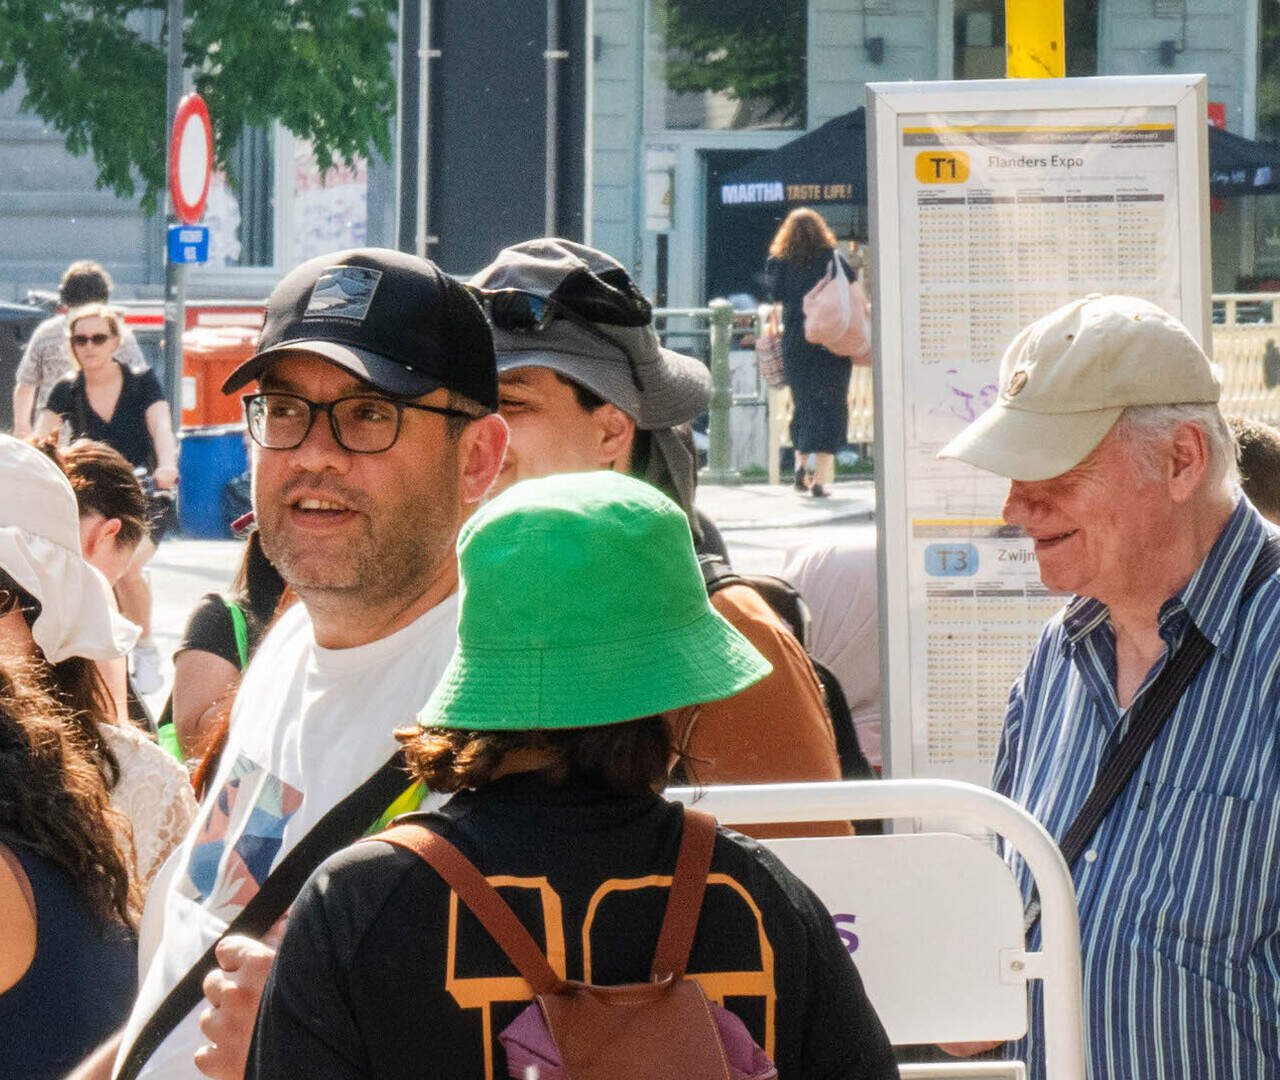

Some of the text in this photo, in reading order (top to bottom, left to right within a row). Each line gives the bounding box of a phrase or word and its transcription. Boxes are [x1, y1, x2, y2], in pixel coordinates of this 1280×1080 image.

[930, 155, 1083, 178] T1 Flanders Expo
[722, 183, 784, 204] MARTHA
[787, 184, 821, 200] TASTE
[936, 550, 968, 571] T3
